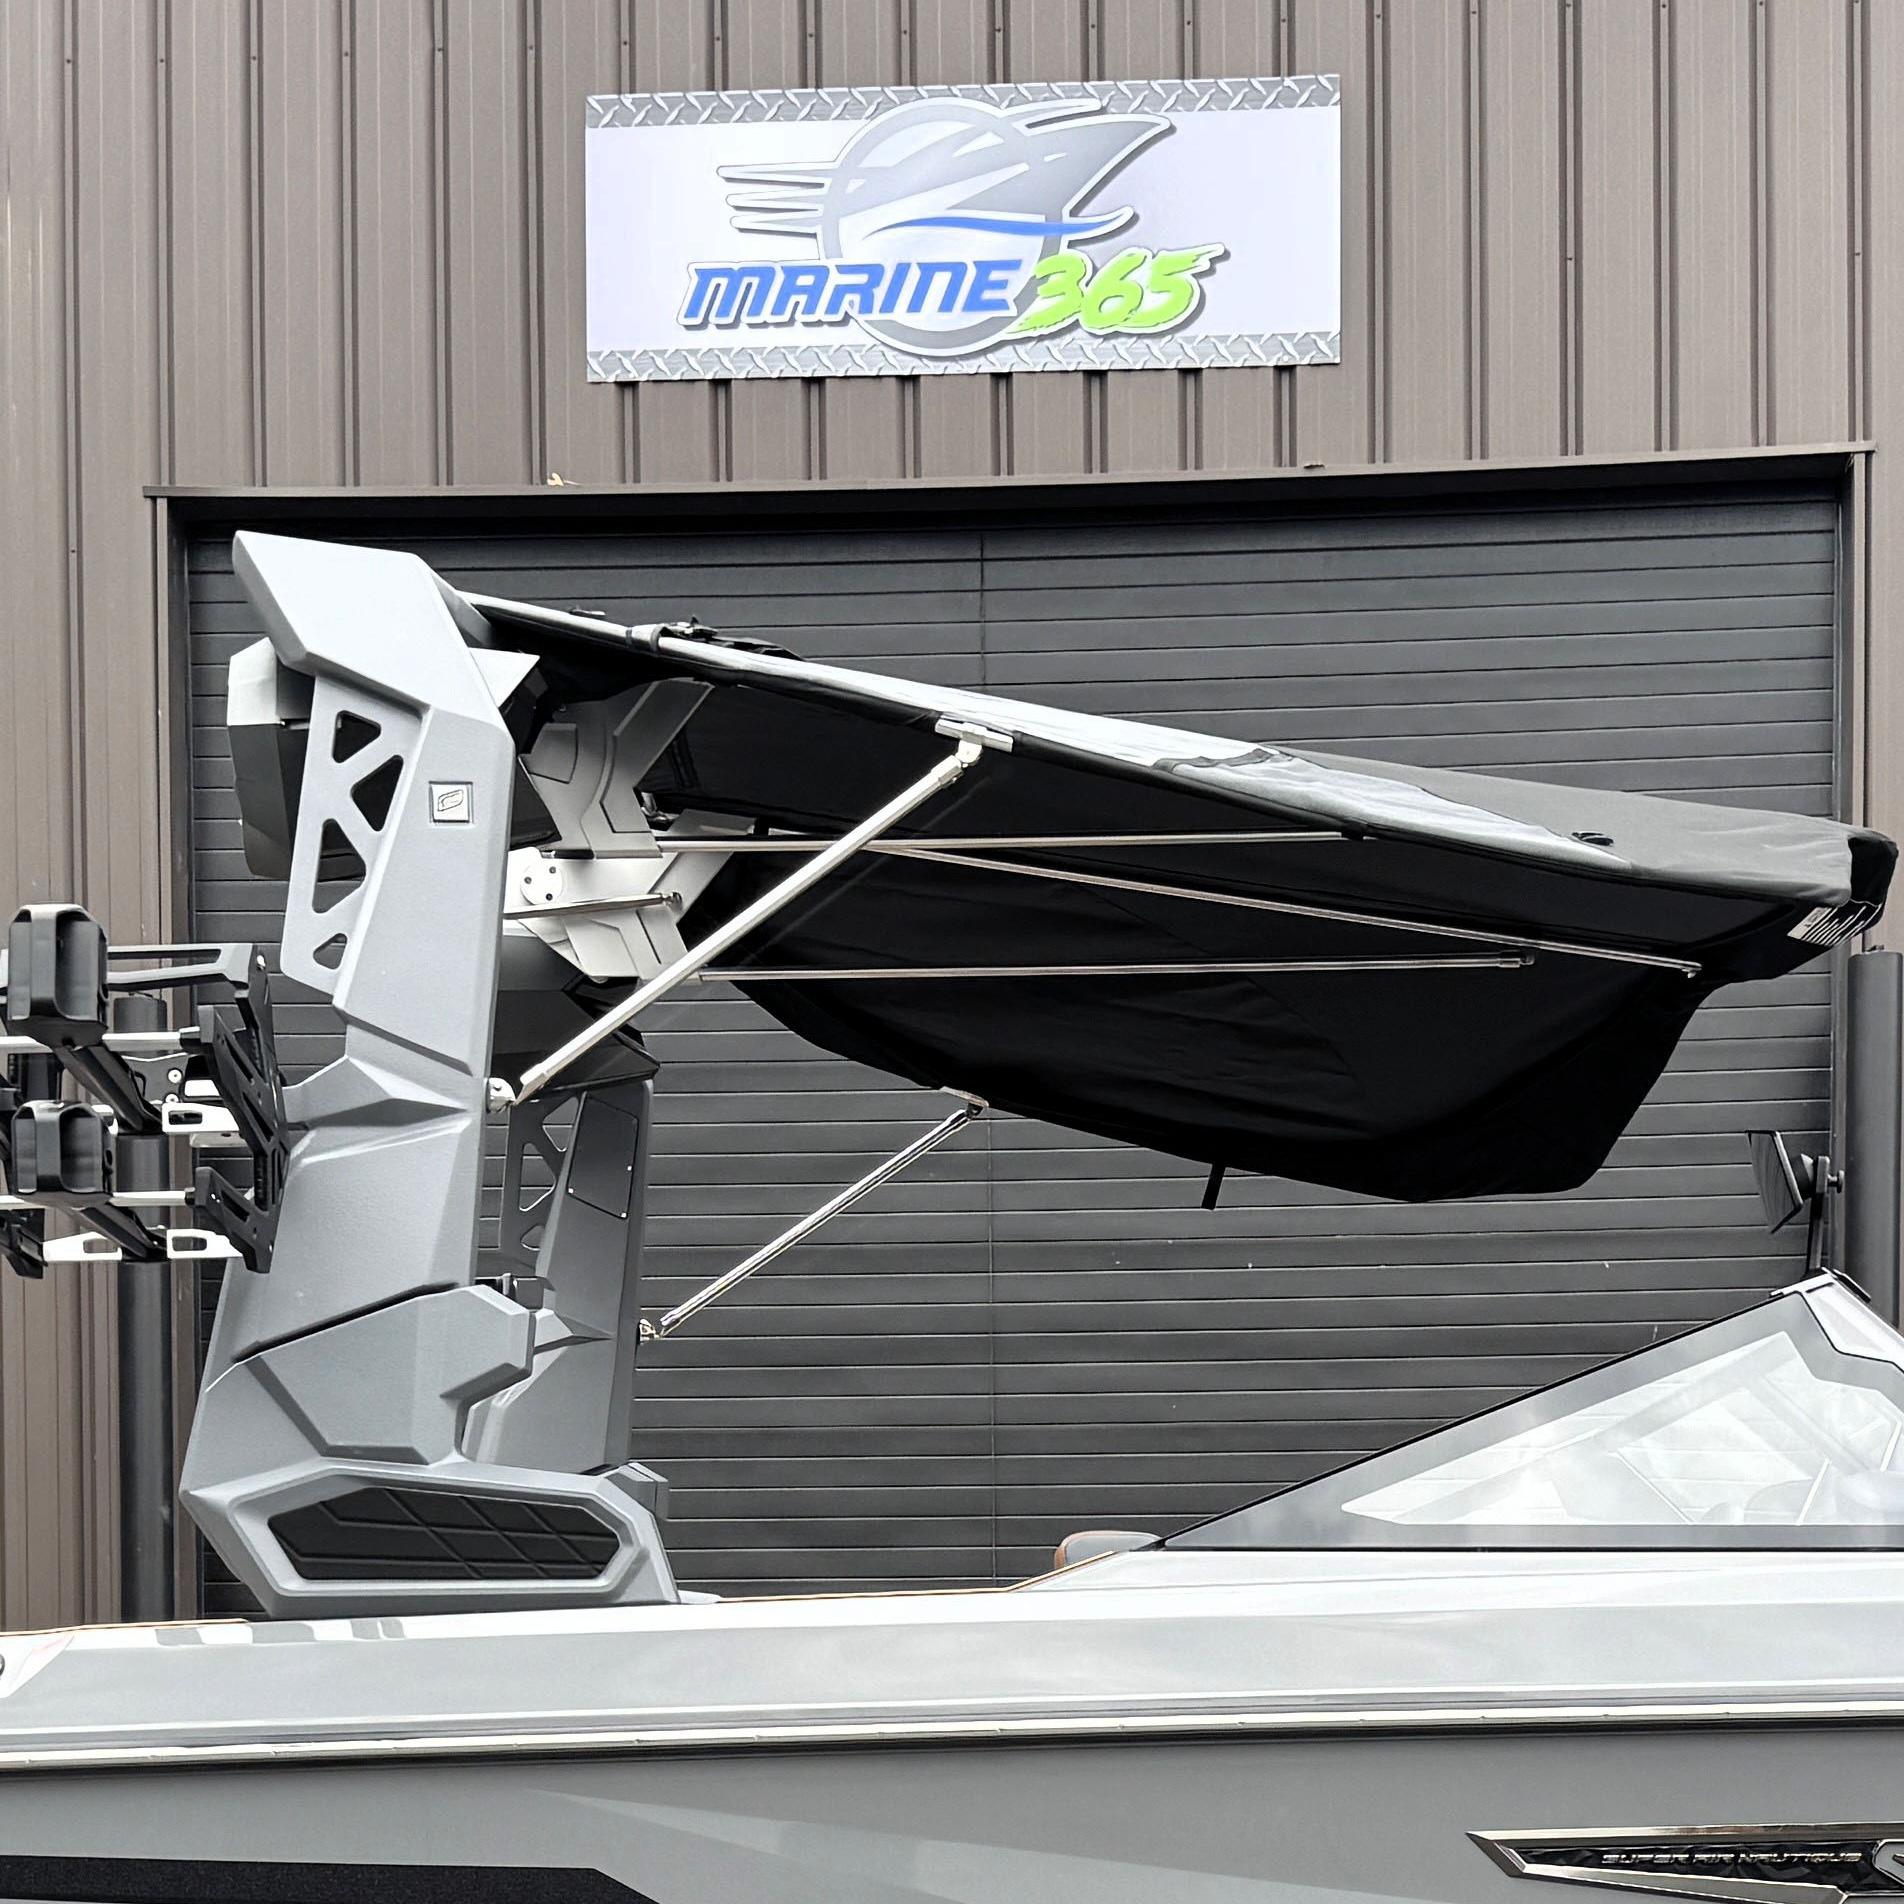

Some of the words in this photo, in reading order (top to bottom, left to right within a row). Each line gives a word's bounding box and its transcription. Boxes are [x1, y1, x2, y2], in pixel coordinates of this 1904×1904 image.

[1602, 1853, 1689, 1865] SUPER
[1693, 1853, 1735, 1865] AIR
[1738, 1852, 1863, 1864] NAUTIQUE
